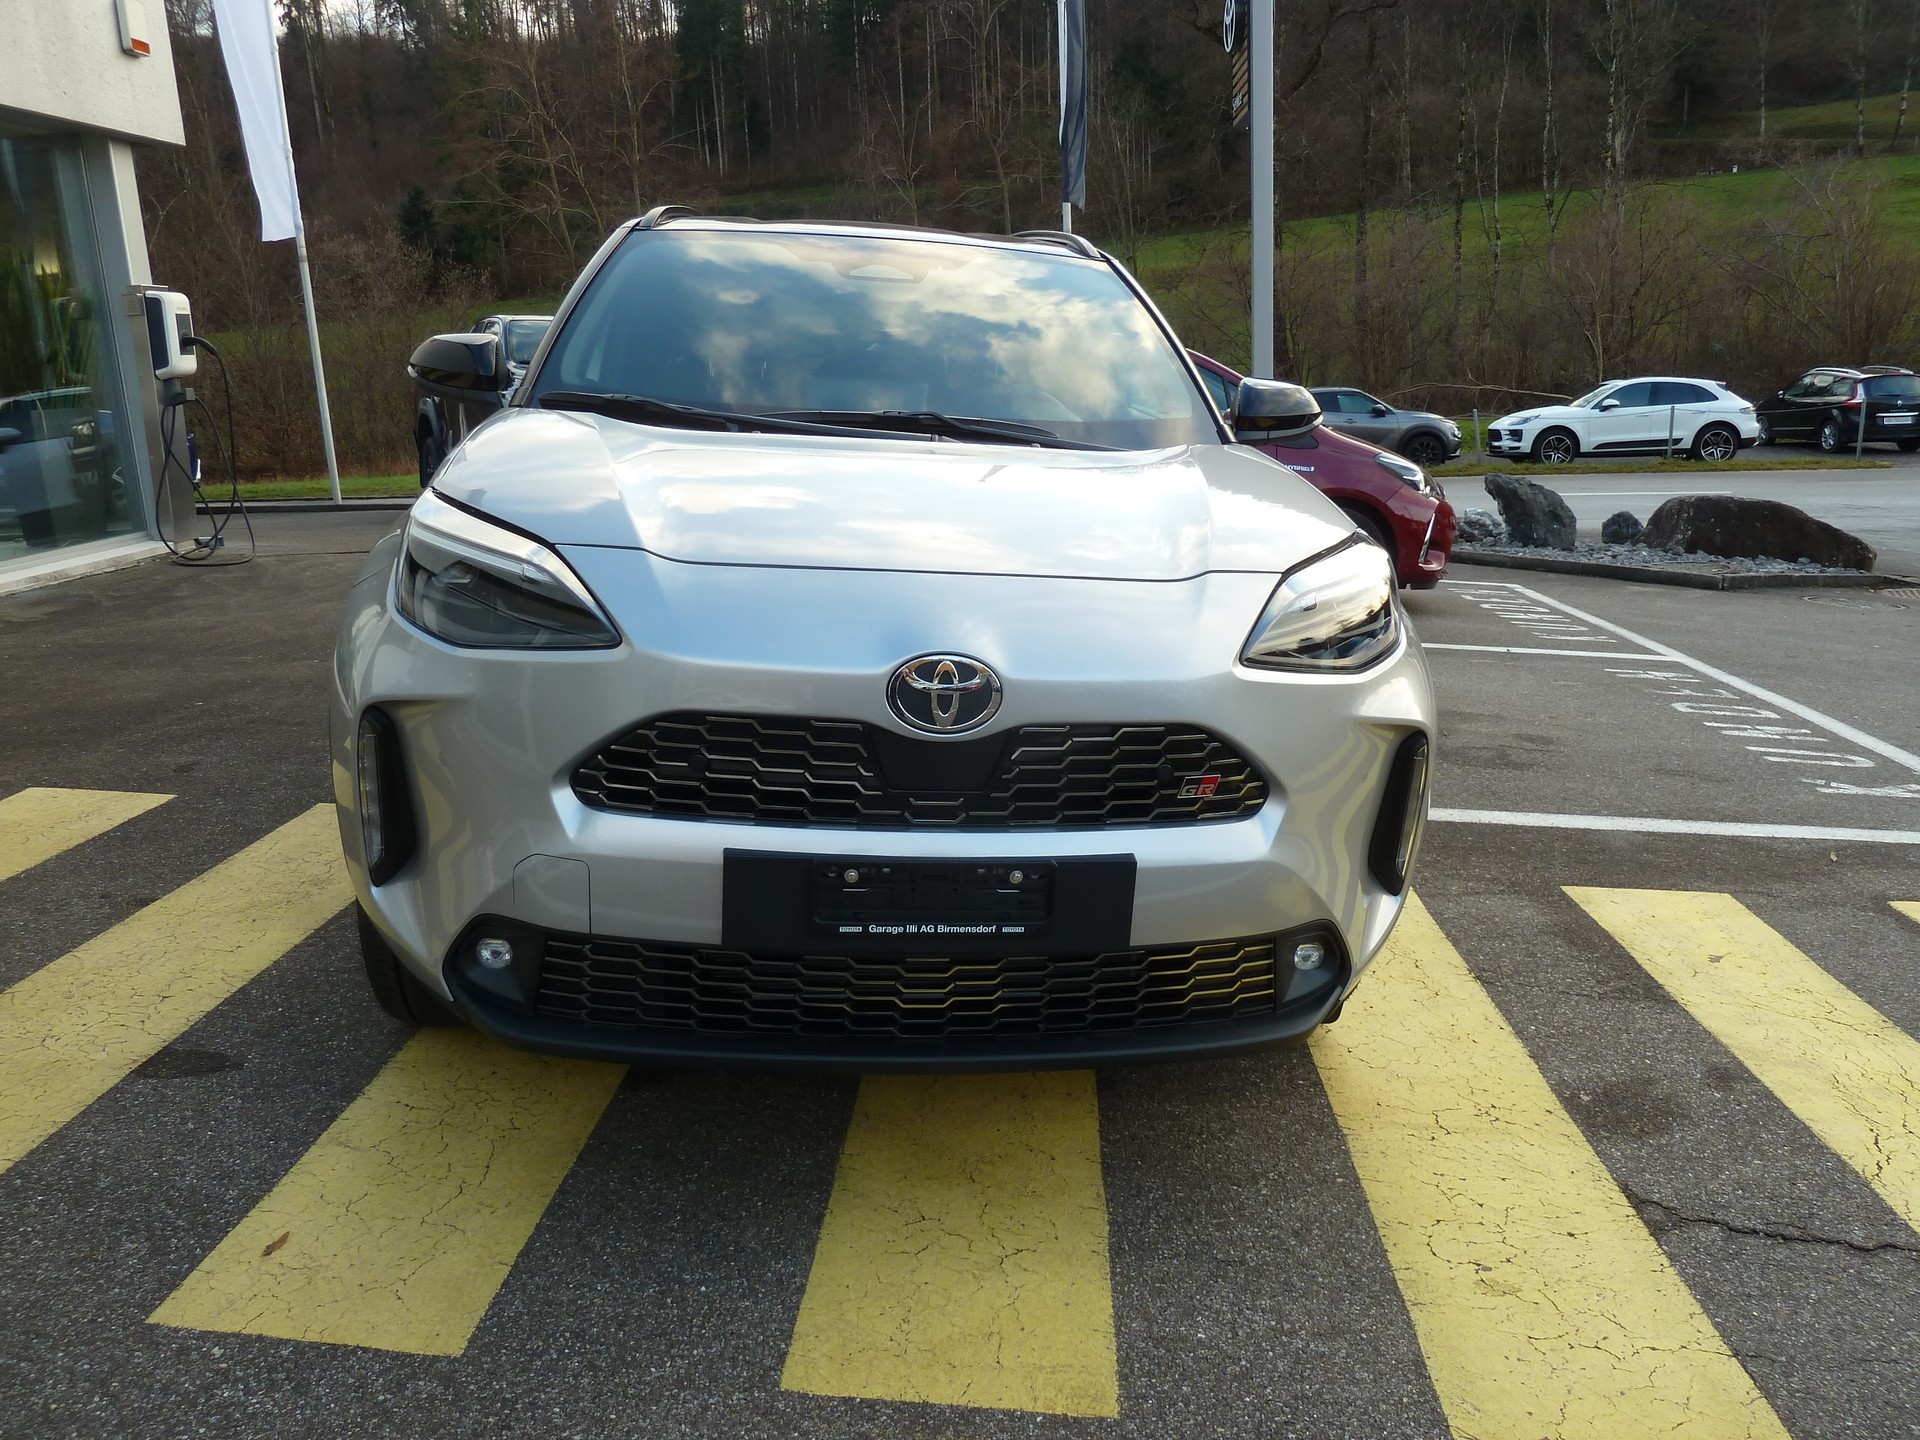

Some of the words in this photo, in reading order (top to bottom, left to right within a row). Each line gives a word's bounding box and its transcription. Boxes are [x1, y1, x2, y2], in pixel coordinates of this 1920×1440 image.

[1181, 784, 1214, 795] GR
[868, 925, 903, 934] Garage
[920, 925, 934, 933] AG
[937, 925, 996, 933] Birmensdorf
